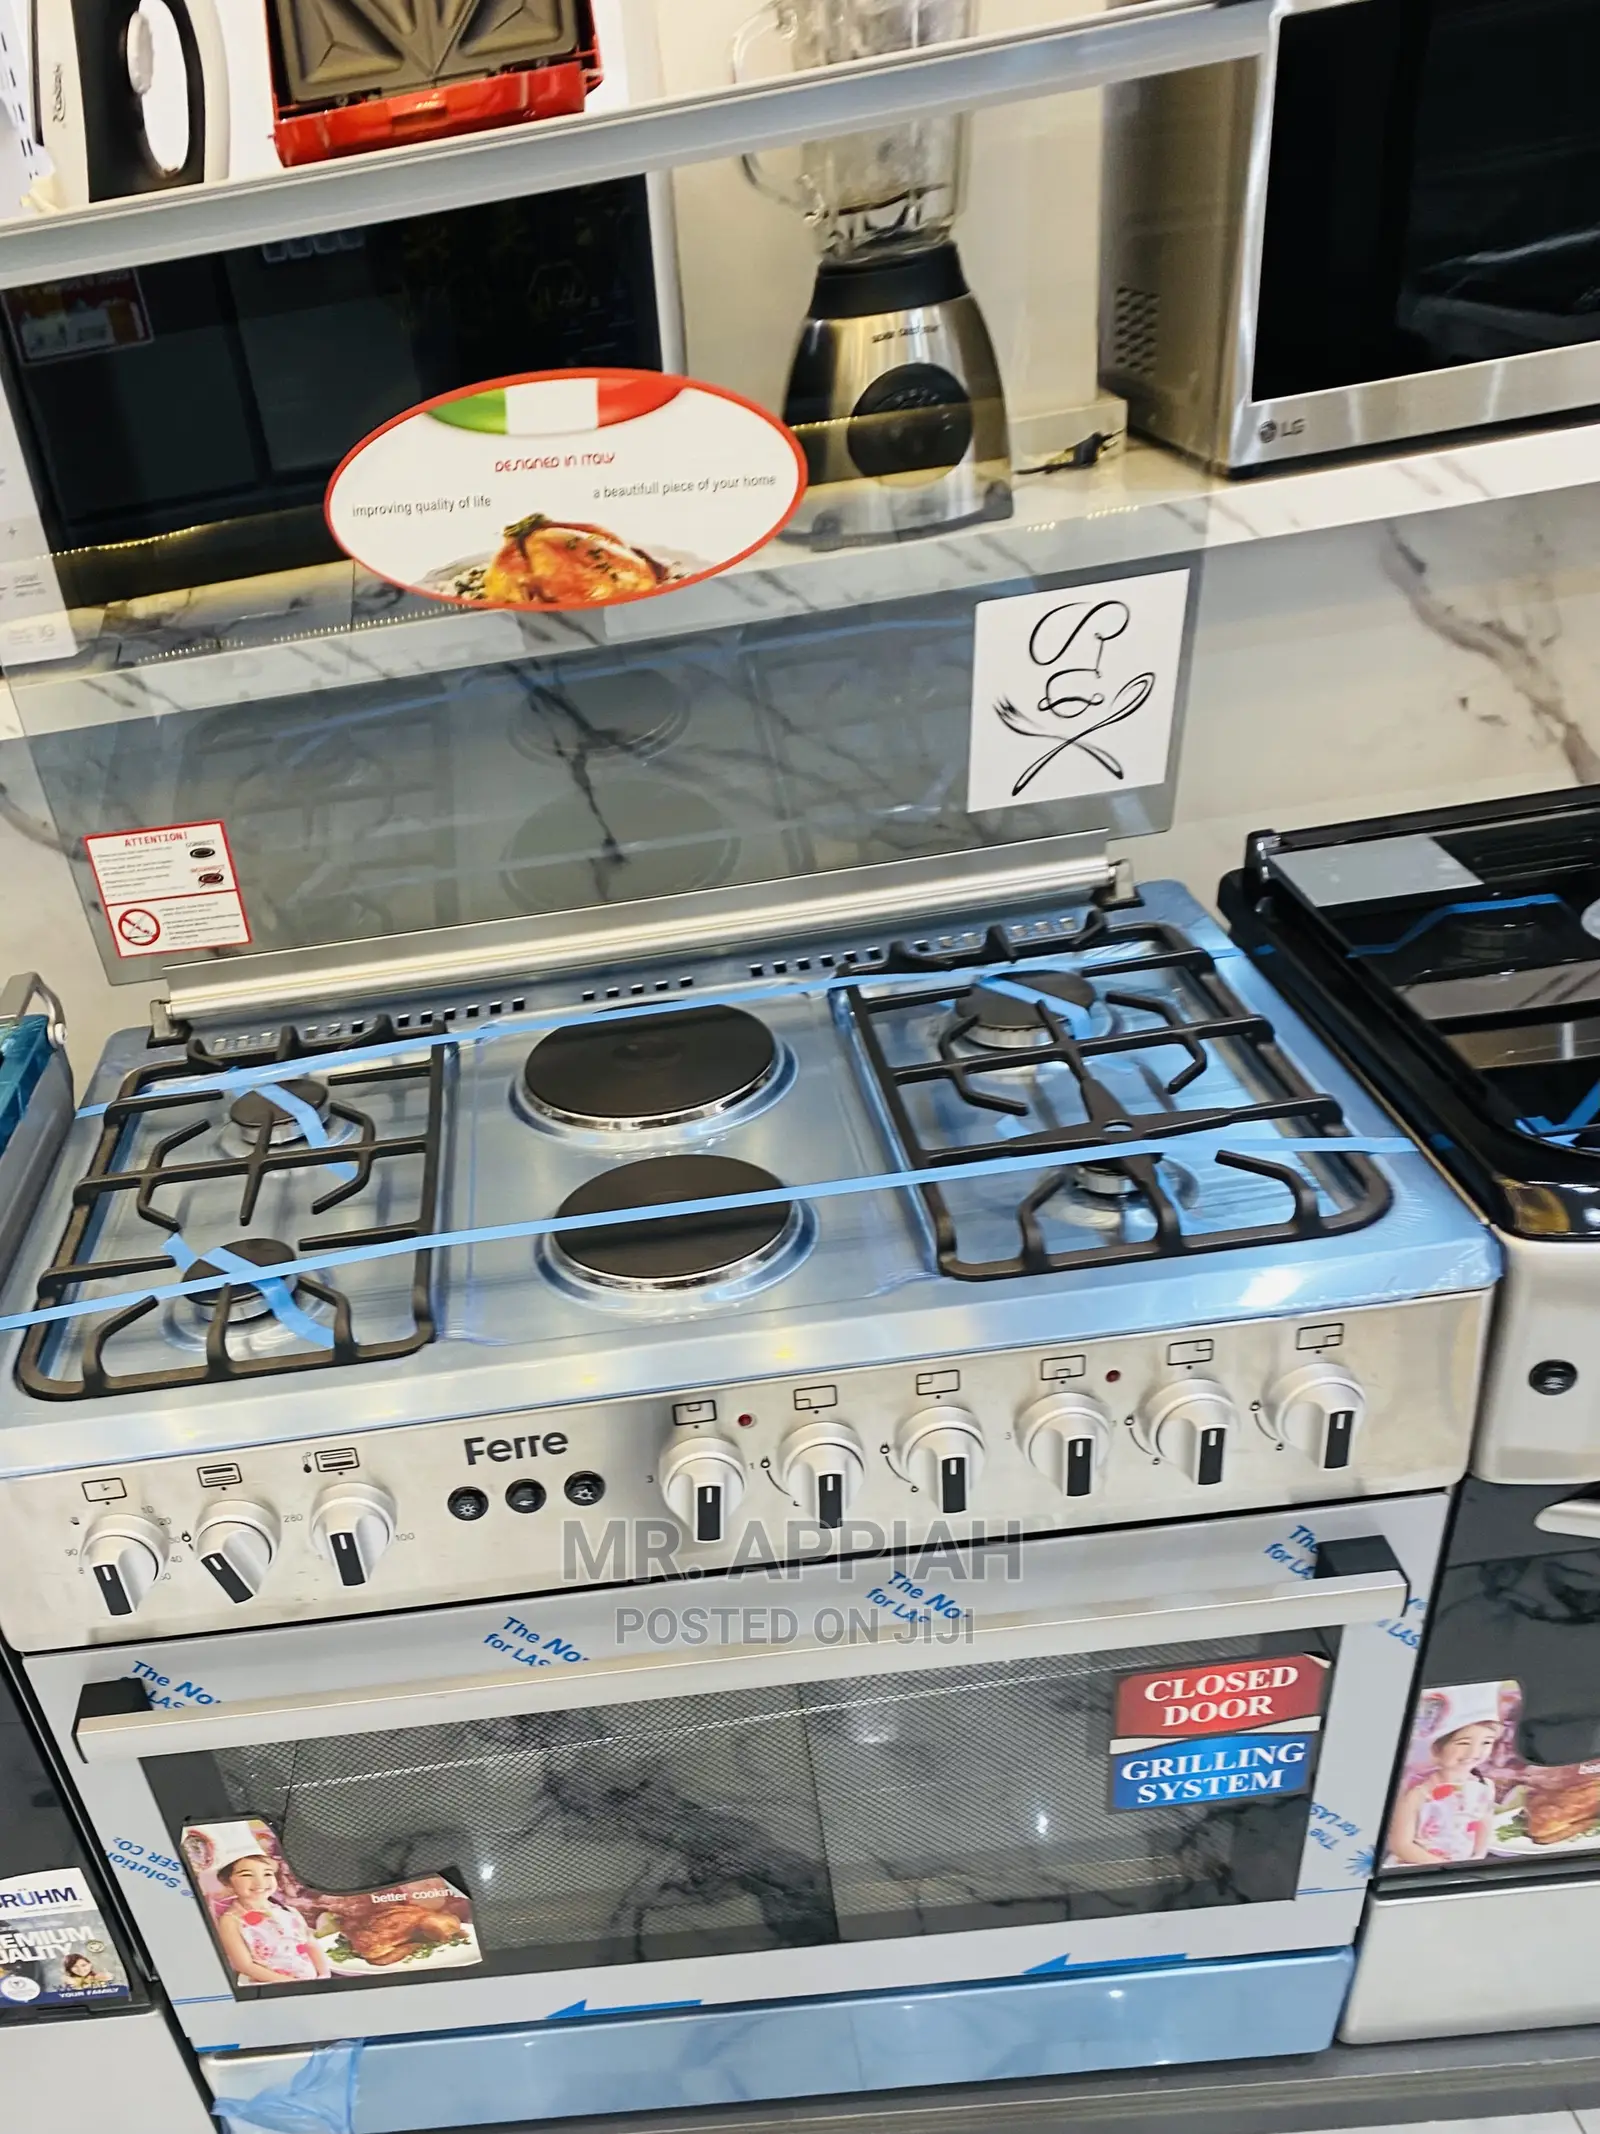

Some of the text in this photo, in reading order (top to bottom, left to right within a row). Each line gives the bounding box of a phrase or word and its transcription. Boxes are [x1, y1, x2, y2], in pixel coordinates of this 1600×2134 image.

[495, 456, 560, 472] DESIGNED
[593, 474, 777, 499] a beautifull piece of your home
[352, 495, 492, 518] improving quality of life
[124, 832, 188, 847] ATTENTION!
[464, 1432, 569, 1465] Ferre
[1264, 1543, 1293, 1563] for
[886, 1570, 924, 1600] The
[865, 1587, 895, 1609] for
[503, 1615, 540, 1643] The
[483, 1633, 514, 1652] for
[132, 1660, 171, 1686] The
[1144, 1666, 1298, 1702] CLOSED
[1161, 1695, 1274, 1726] DOOR
[1121, 1742, 1306, 1781] GRILLING
[1137, 1769, 1286, 1804] SYSTEM
[370, 1887, 455, 1904] better cookin
[0, 1926, 95, 1949] EMIUM
